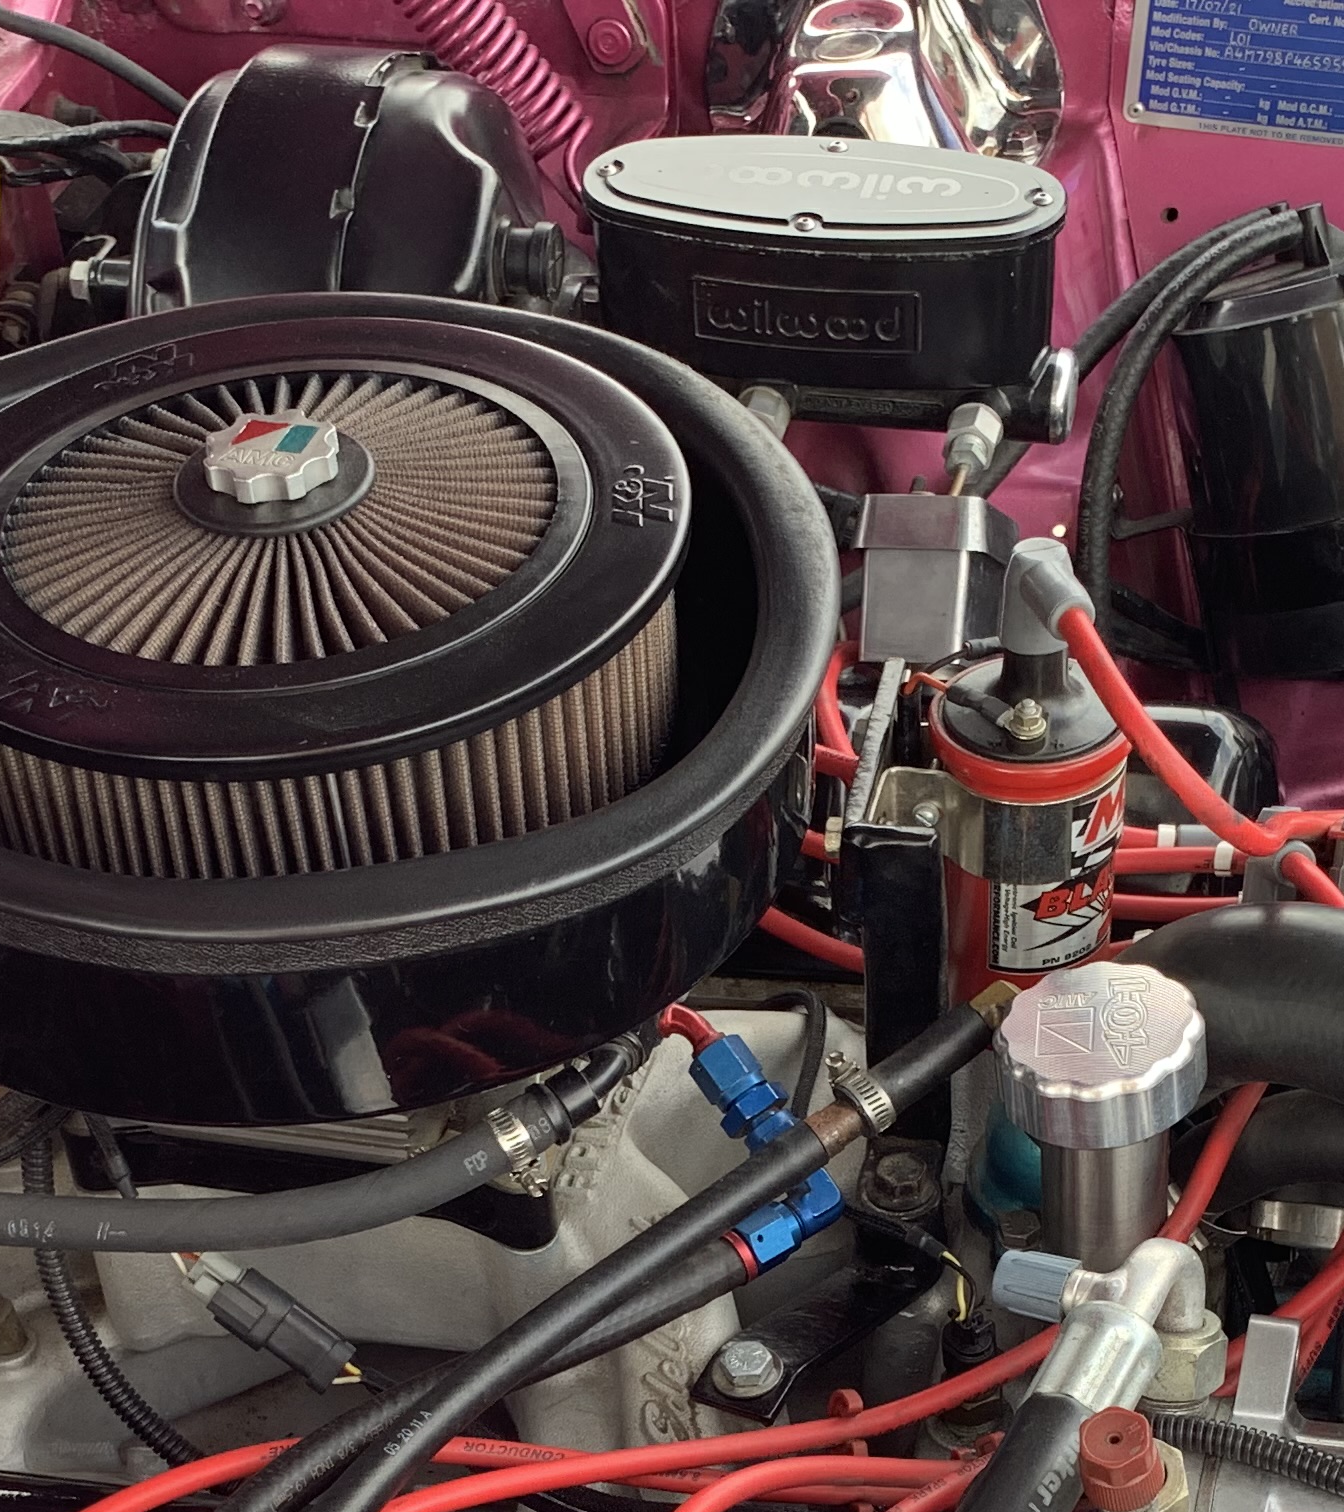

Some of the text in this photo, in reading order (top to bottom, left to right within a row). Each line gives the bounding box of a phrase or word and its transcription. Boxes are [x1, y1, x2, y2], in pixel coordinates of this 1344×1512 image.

[1150, 26, 1205, 41] Mod Codes:
[1152, 11, 1210, 28] Modification
[1212, 17, 1228, 30] By:
[1248, 19, 1298, 36] OWNER
[1149, 41, 1203, 57] Vin/Chassis
[1204, 46, 1220, 58] No:
[1148, 55, 1167, 67] Tyre
[1145, 70, 1166, 81] Mod
[1167, 72, 1202, 88] Seating
[718, 162, 963, 202] wilwoo
[707, 300, 903, 342] wilwood
[462, 1440, 566, 1462] CONDUCTOR
